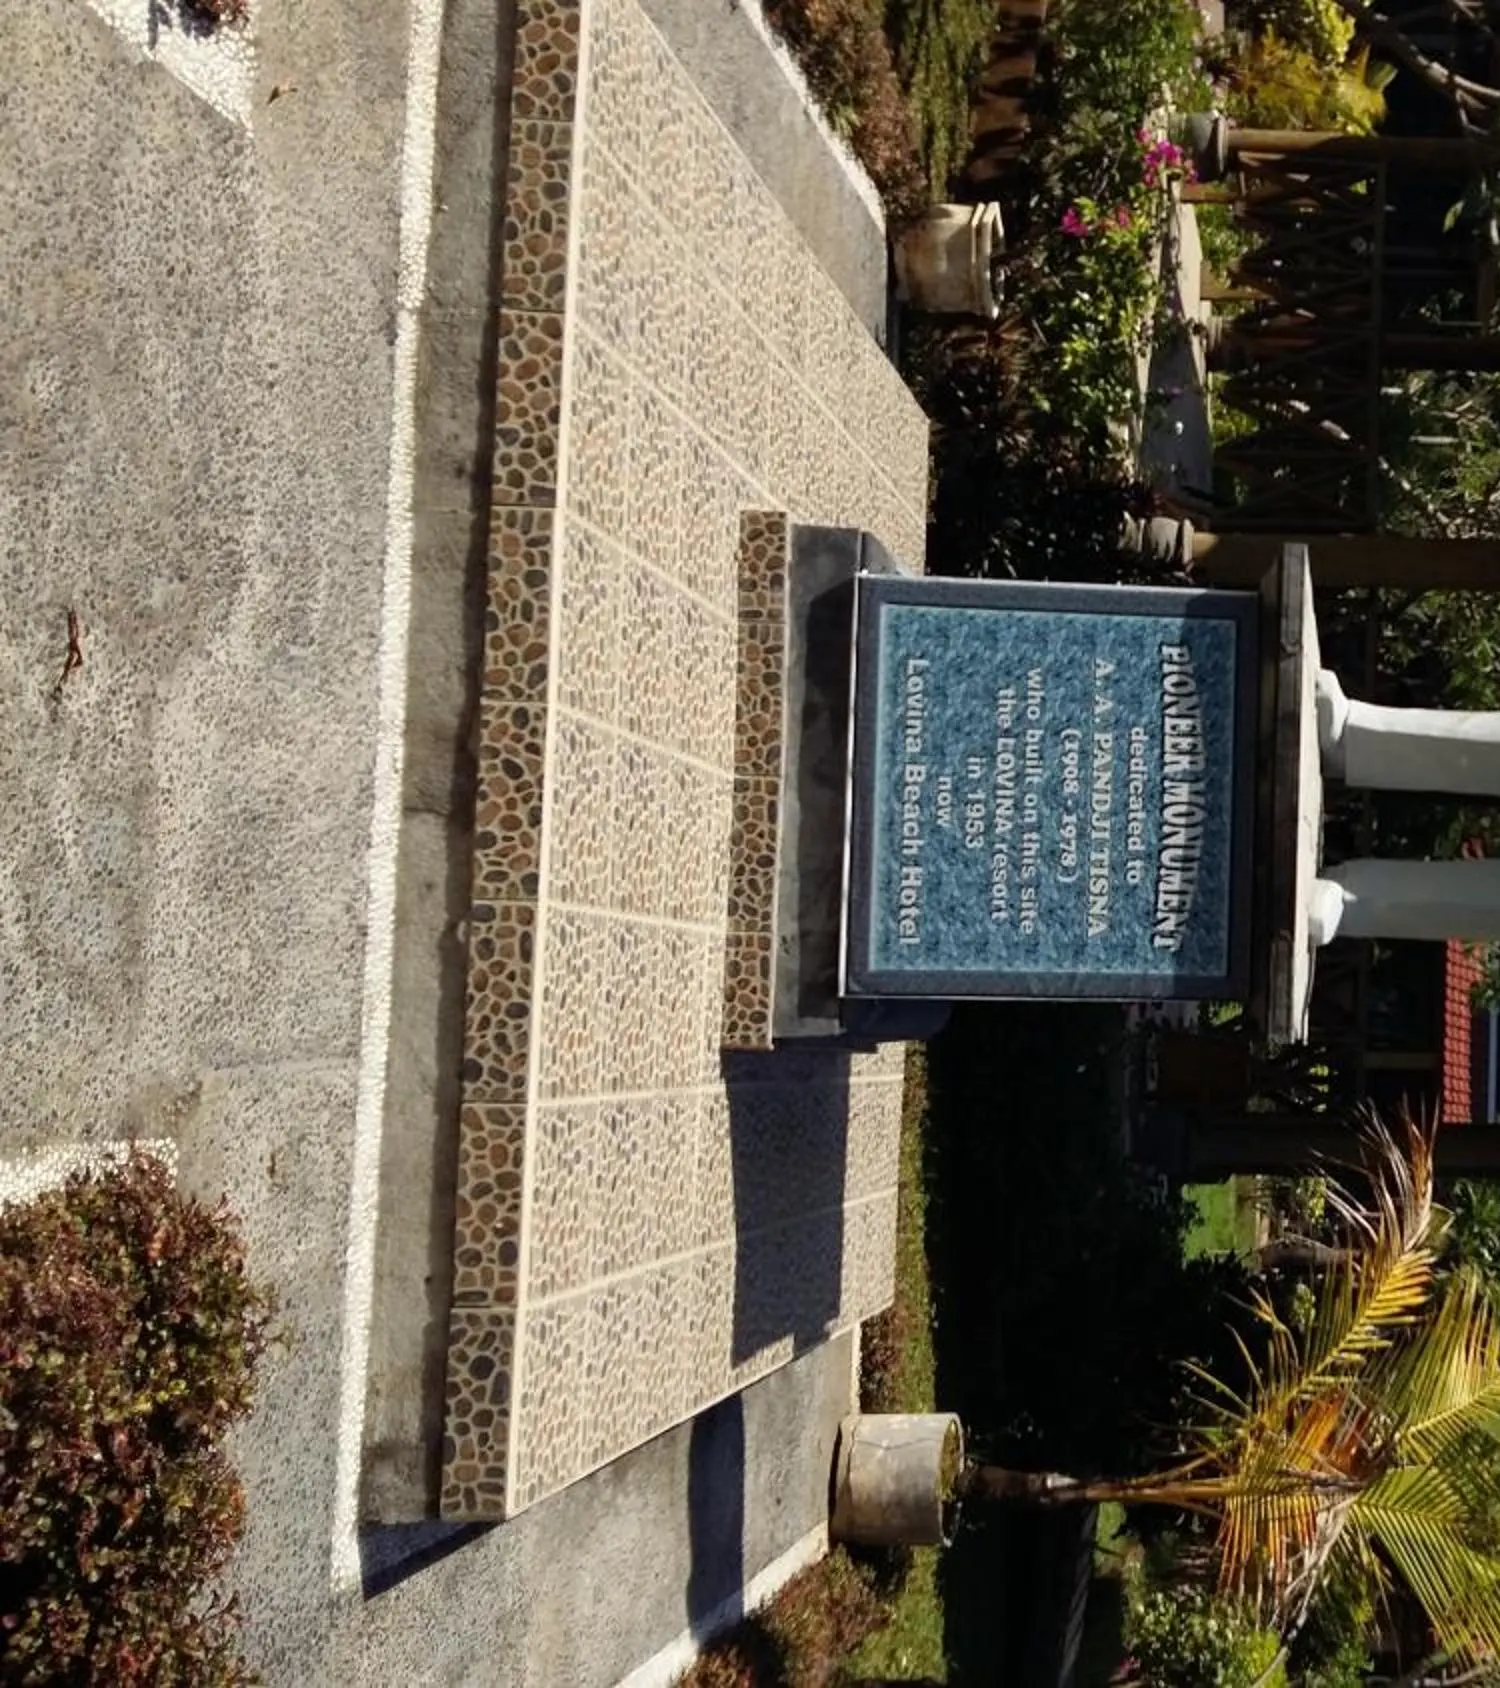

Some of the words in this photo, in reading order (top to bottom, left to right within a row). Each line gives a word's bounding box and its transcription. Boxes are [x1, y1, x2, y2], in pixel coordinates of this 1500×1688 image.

[1026, 668, 1043, 720] who
[1094, 658, 1112, 686] A.
[904, 659, 928, 753] Lovina
[997, 687, 1015, 728] the
[1093, 695, 1111, 722] A.
[1159, 644, 1203, 774] PIONEER
[967, 757, 984, 778] in
[993, 738, 1015, 834] LOVINA
[1024, 730, 1044, 783] built
[1061, 728, 1079, 793] (1908
[1090, 733, 1112, 840] PANDJI
[901, 764, 924, 855] Beach
[936, 776, 953, 827] now
[1023, 794, 1038, 823] on
[1126, 727, 1148, 850] dedicated
[964, 789, 984, 849] 1953
[992, 842, 1012, 921] resort
[1021, 832, 1041, 878] this
[1126, 859, 1145, 885] to
[1152, 780, 1206, 953] MONUMENT
[899, 866, 922, 945] Hotel
[1020, 888, 1040, 935] site
[1087, 848, 1109, 937] TISNA
